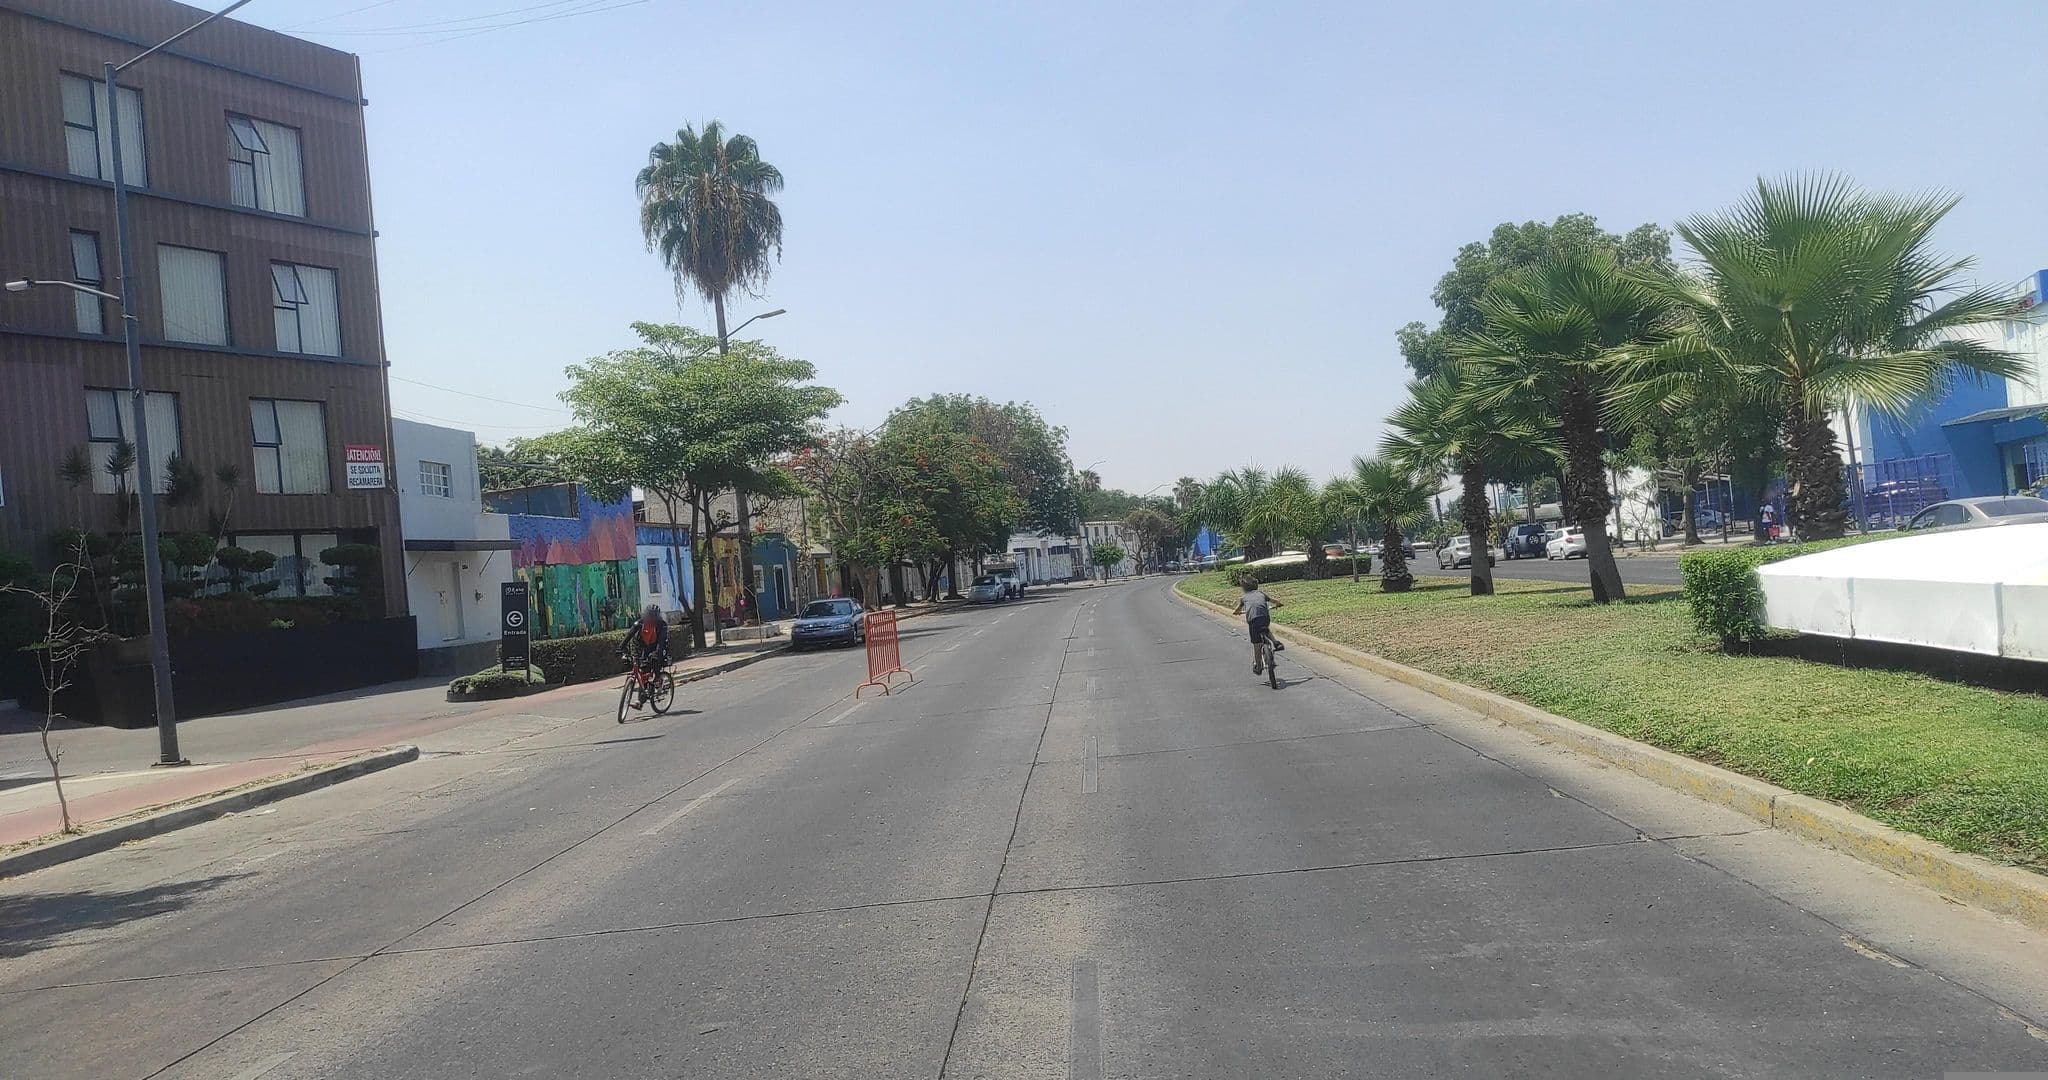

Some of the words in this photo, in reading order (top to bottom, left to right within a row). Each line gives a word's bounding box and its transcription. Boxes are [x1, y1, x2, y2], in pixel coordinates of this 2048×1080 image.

[350, 466, 358, 474] SE
[358, 466, 381, 474] SOLICITA
[349, 477, 383, 486] RECAMARERA
